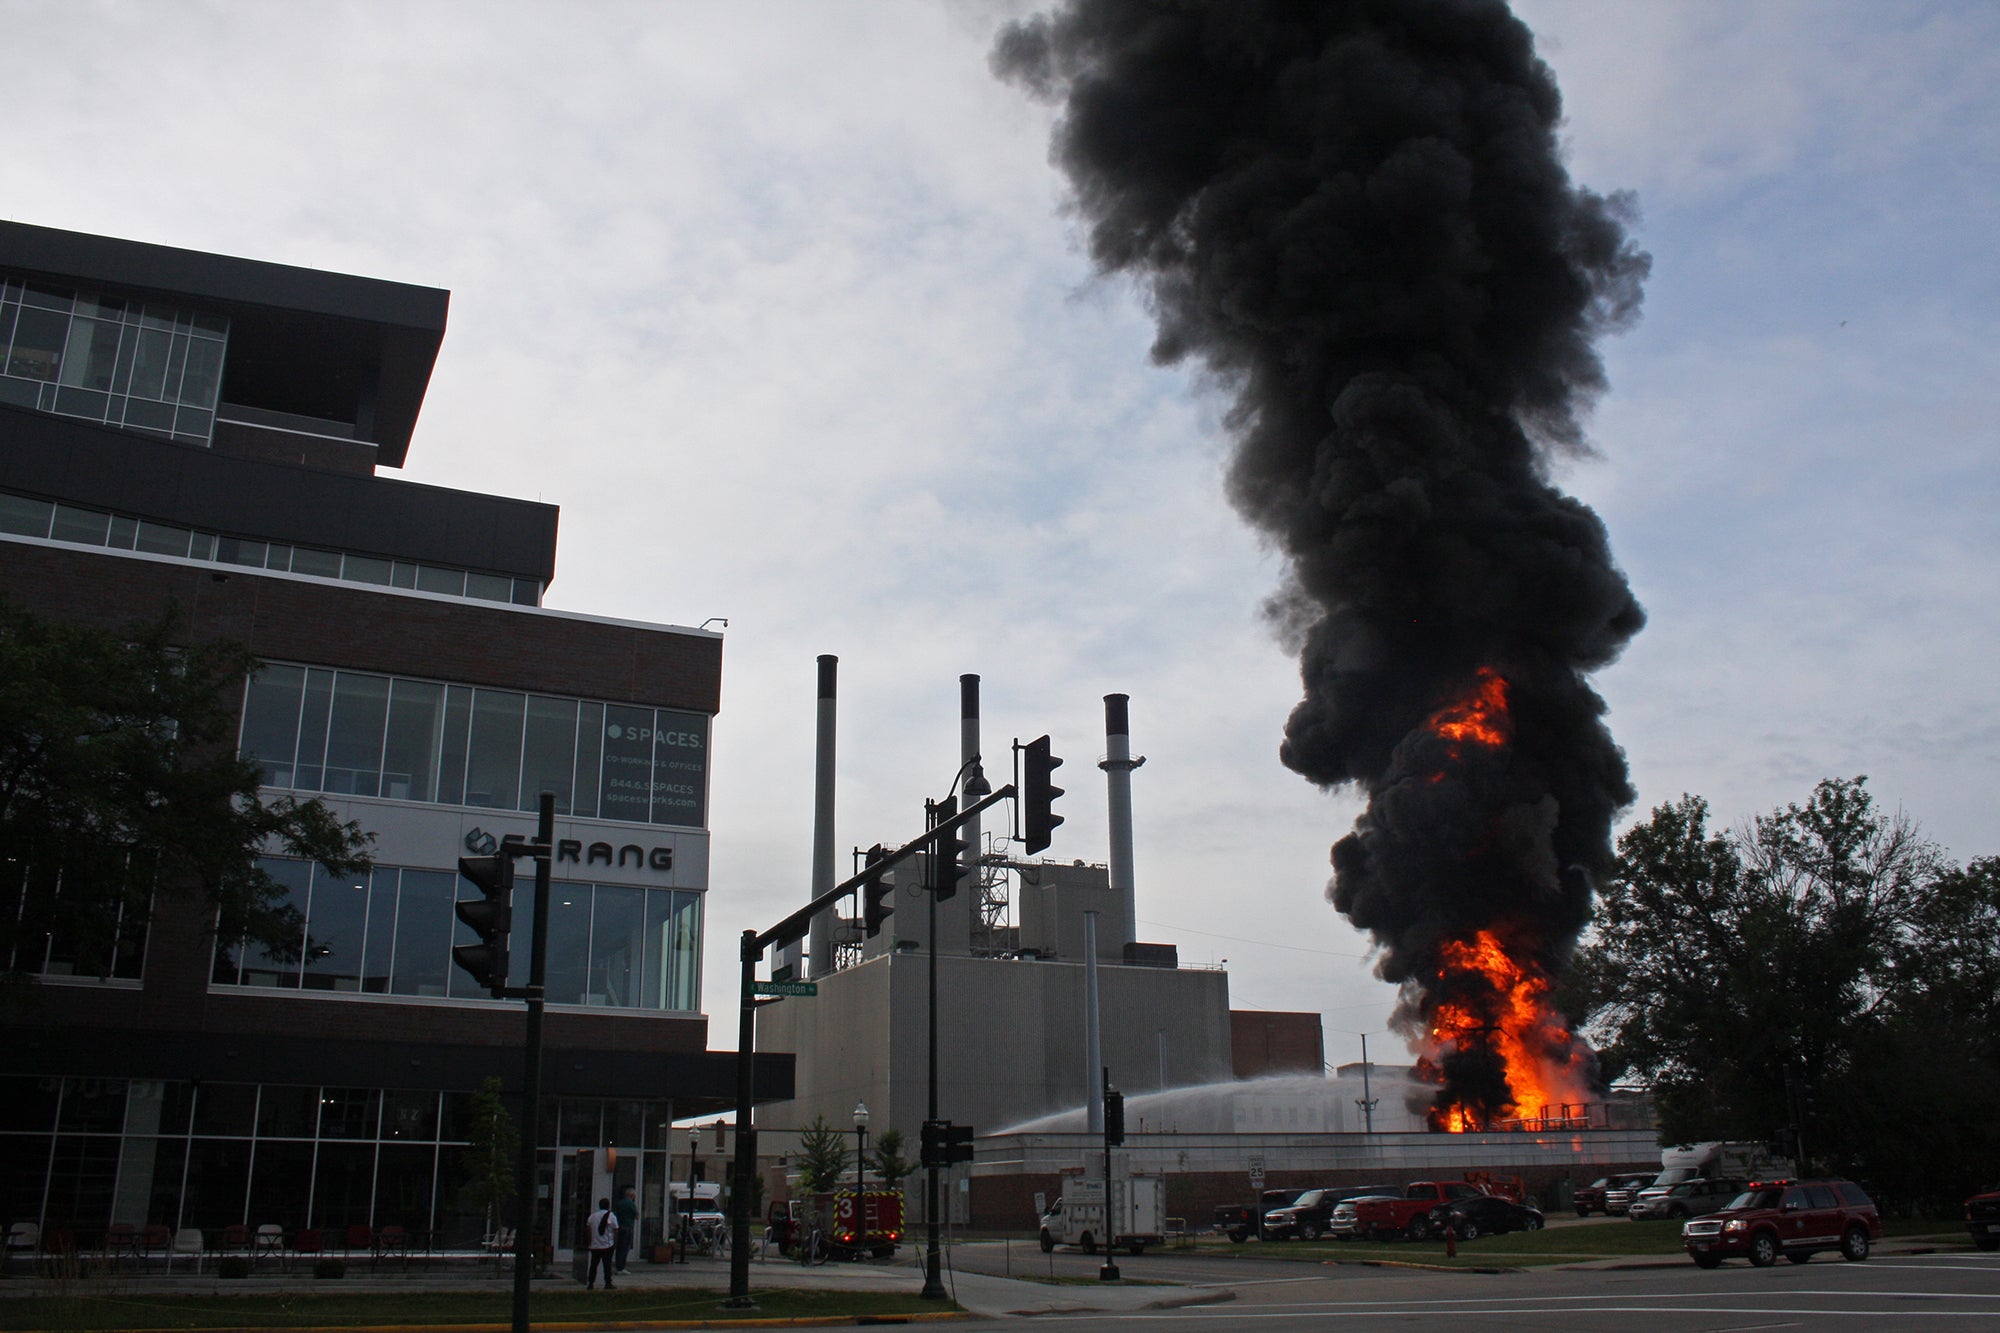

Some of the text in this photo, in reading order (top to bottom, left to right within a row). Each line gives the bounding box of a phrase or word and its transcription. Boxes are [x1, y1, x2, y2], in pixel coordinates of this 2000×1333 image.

[669, 761, 704, 773] OFFICES
[606, 793, 697, 808] spacesworks.com
[502, 833, 674, 871] RANG
[757, 982, 806, 995] Washington
[1250, 1167, 1264, 1177] 25
[840, 1198, 853, 1219] 3
